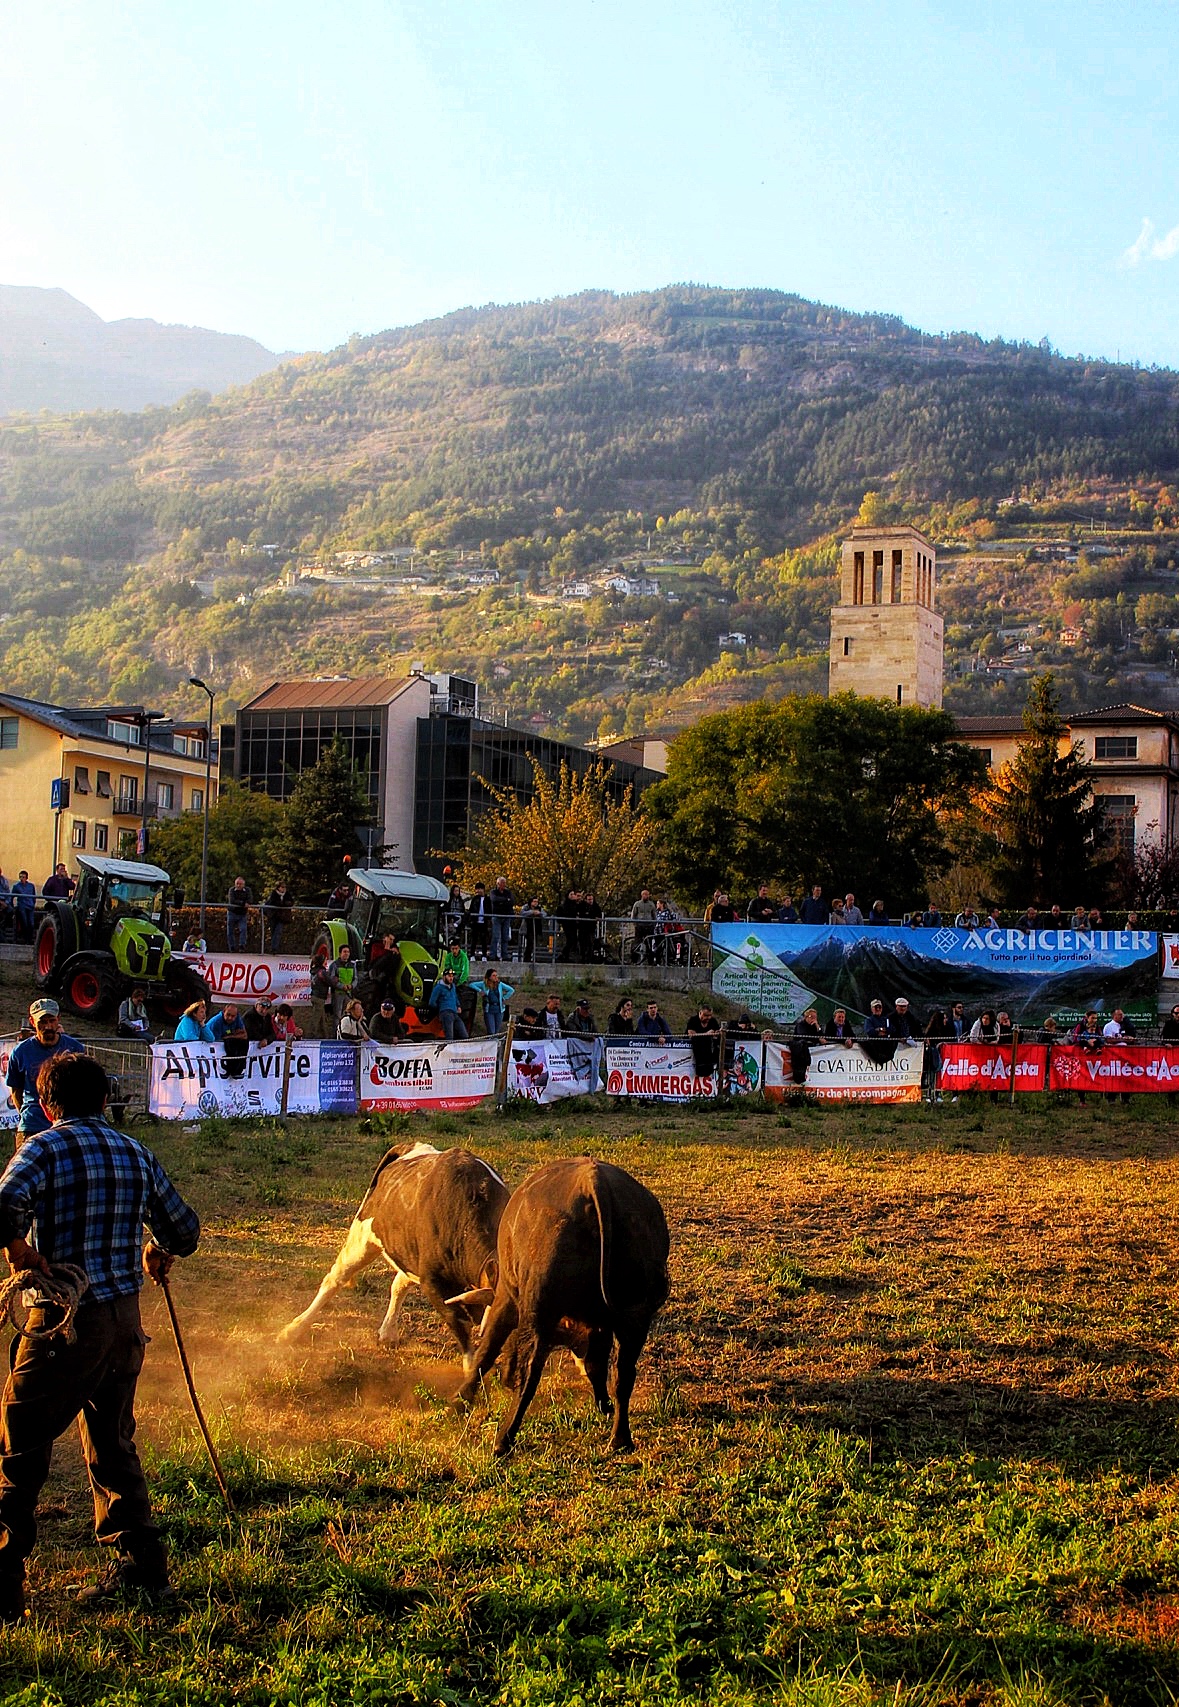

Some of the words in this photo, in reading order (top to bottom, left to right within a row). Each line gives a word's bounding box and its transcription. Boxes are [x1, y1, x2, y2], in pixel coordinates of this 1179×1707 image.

[962, 929, 1152, 950] AGRICENTER
[990, 953, 1011, 961] Tutto
[1029, 953, 1035, 961] il
[1053, 953, 1092, 962] giardino!
[375, 1056, 433, 1079] BOFFA
[817, 1059, 845, 1073] CVA
[849, 1074, 881, 1082] MERCATO
[827, 1088, 841, 1098] che
